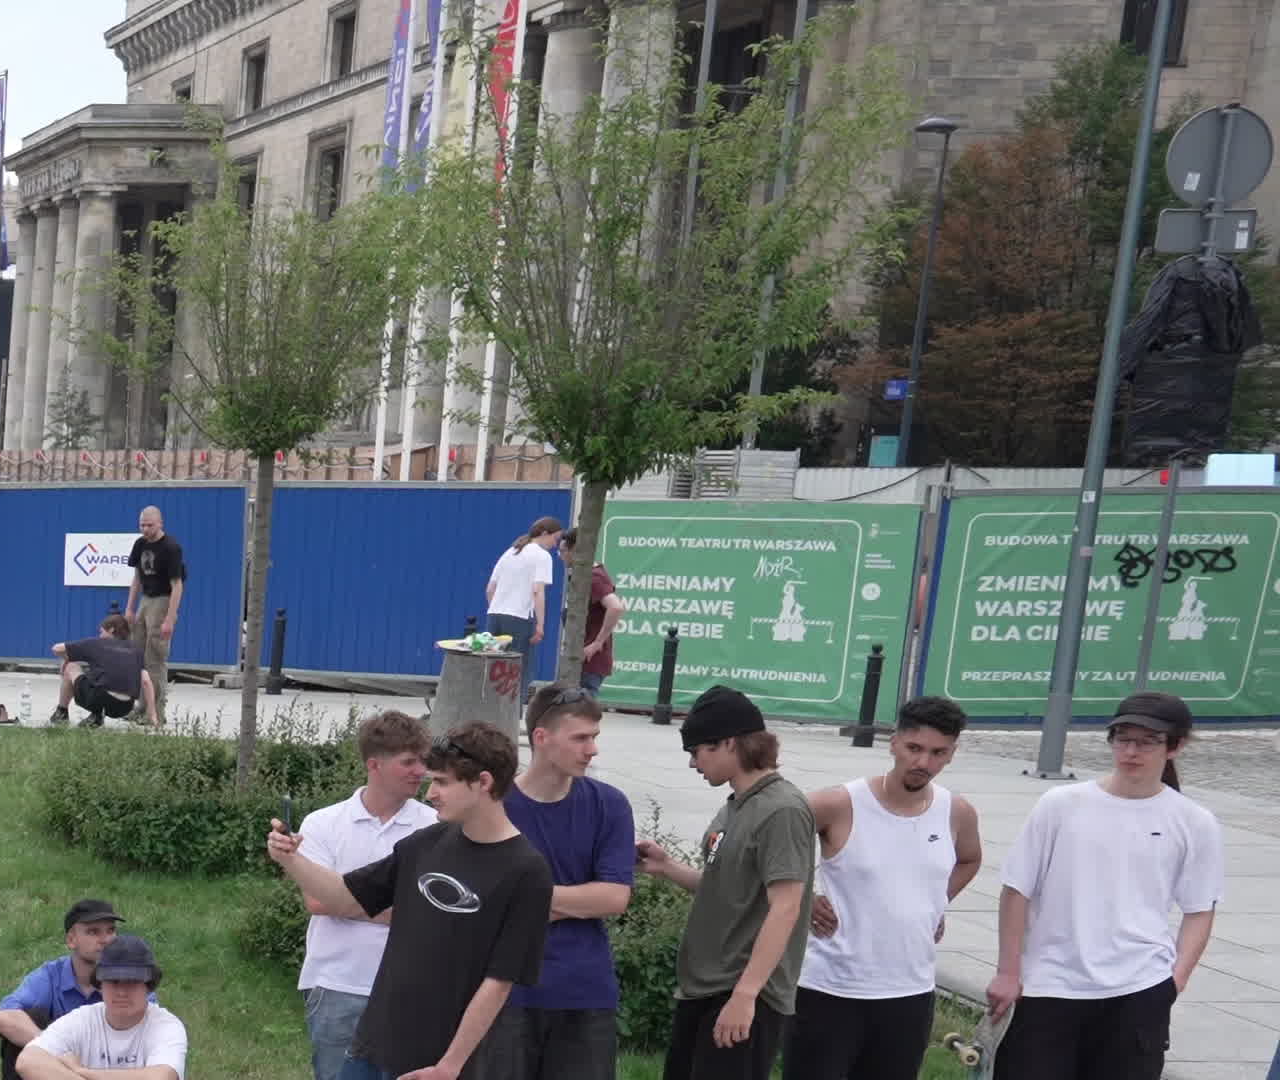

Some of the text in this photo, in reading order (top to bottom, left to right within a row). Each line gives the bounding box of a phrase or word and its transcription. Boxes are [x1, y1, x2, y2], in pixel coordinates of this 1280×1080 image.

[618, 536, 836, 551] BUDOWA TEATRU TR WARSZAWA
[984, 534, 1058, 546] BUDOWA
[1063, 534, 1127, 545] TTRU
[616, 573, 736, 593] ZMIENIAMY
[977, 575, 1123, 592] ZMIENIMY
[975, 599, 1126, 621] WARSZWĘ
[613, 620, 653, 635] DLA
[971, 625, 1021, 641] DLA
[711, 667, 730, 677] ZA
[730, 668, 827, 684] UTRUDNIENIA
[1092, 671, 1113, 681] ZA
[1115, 671, 1227, 681] UTUDNIENIA
